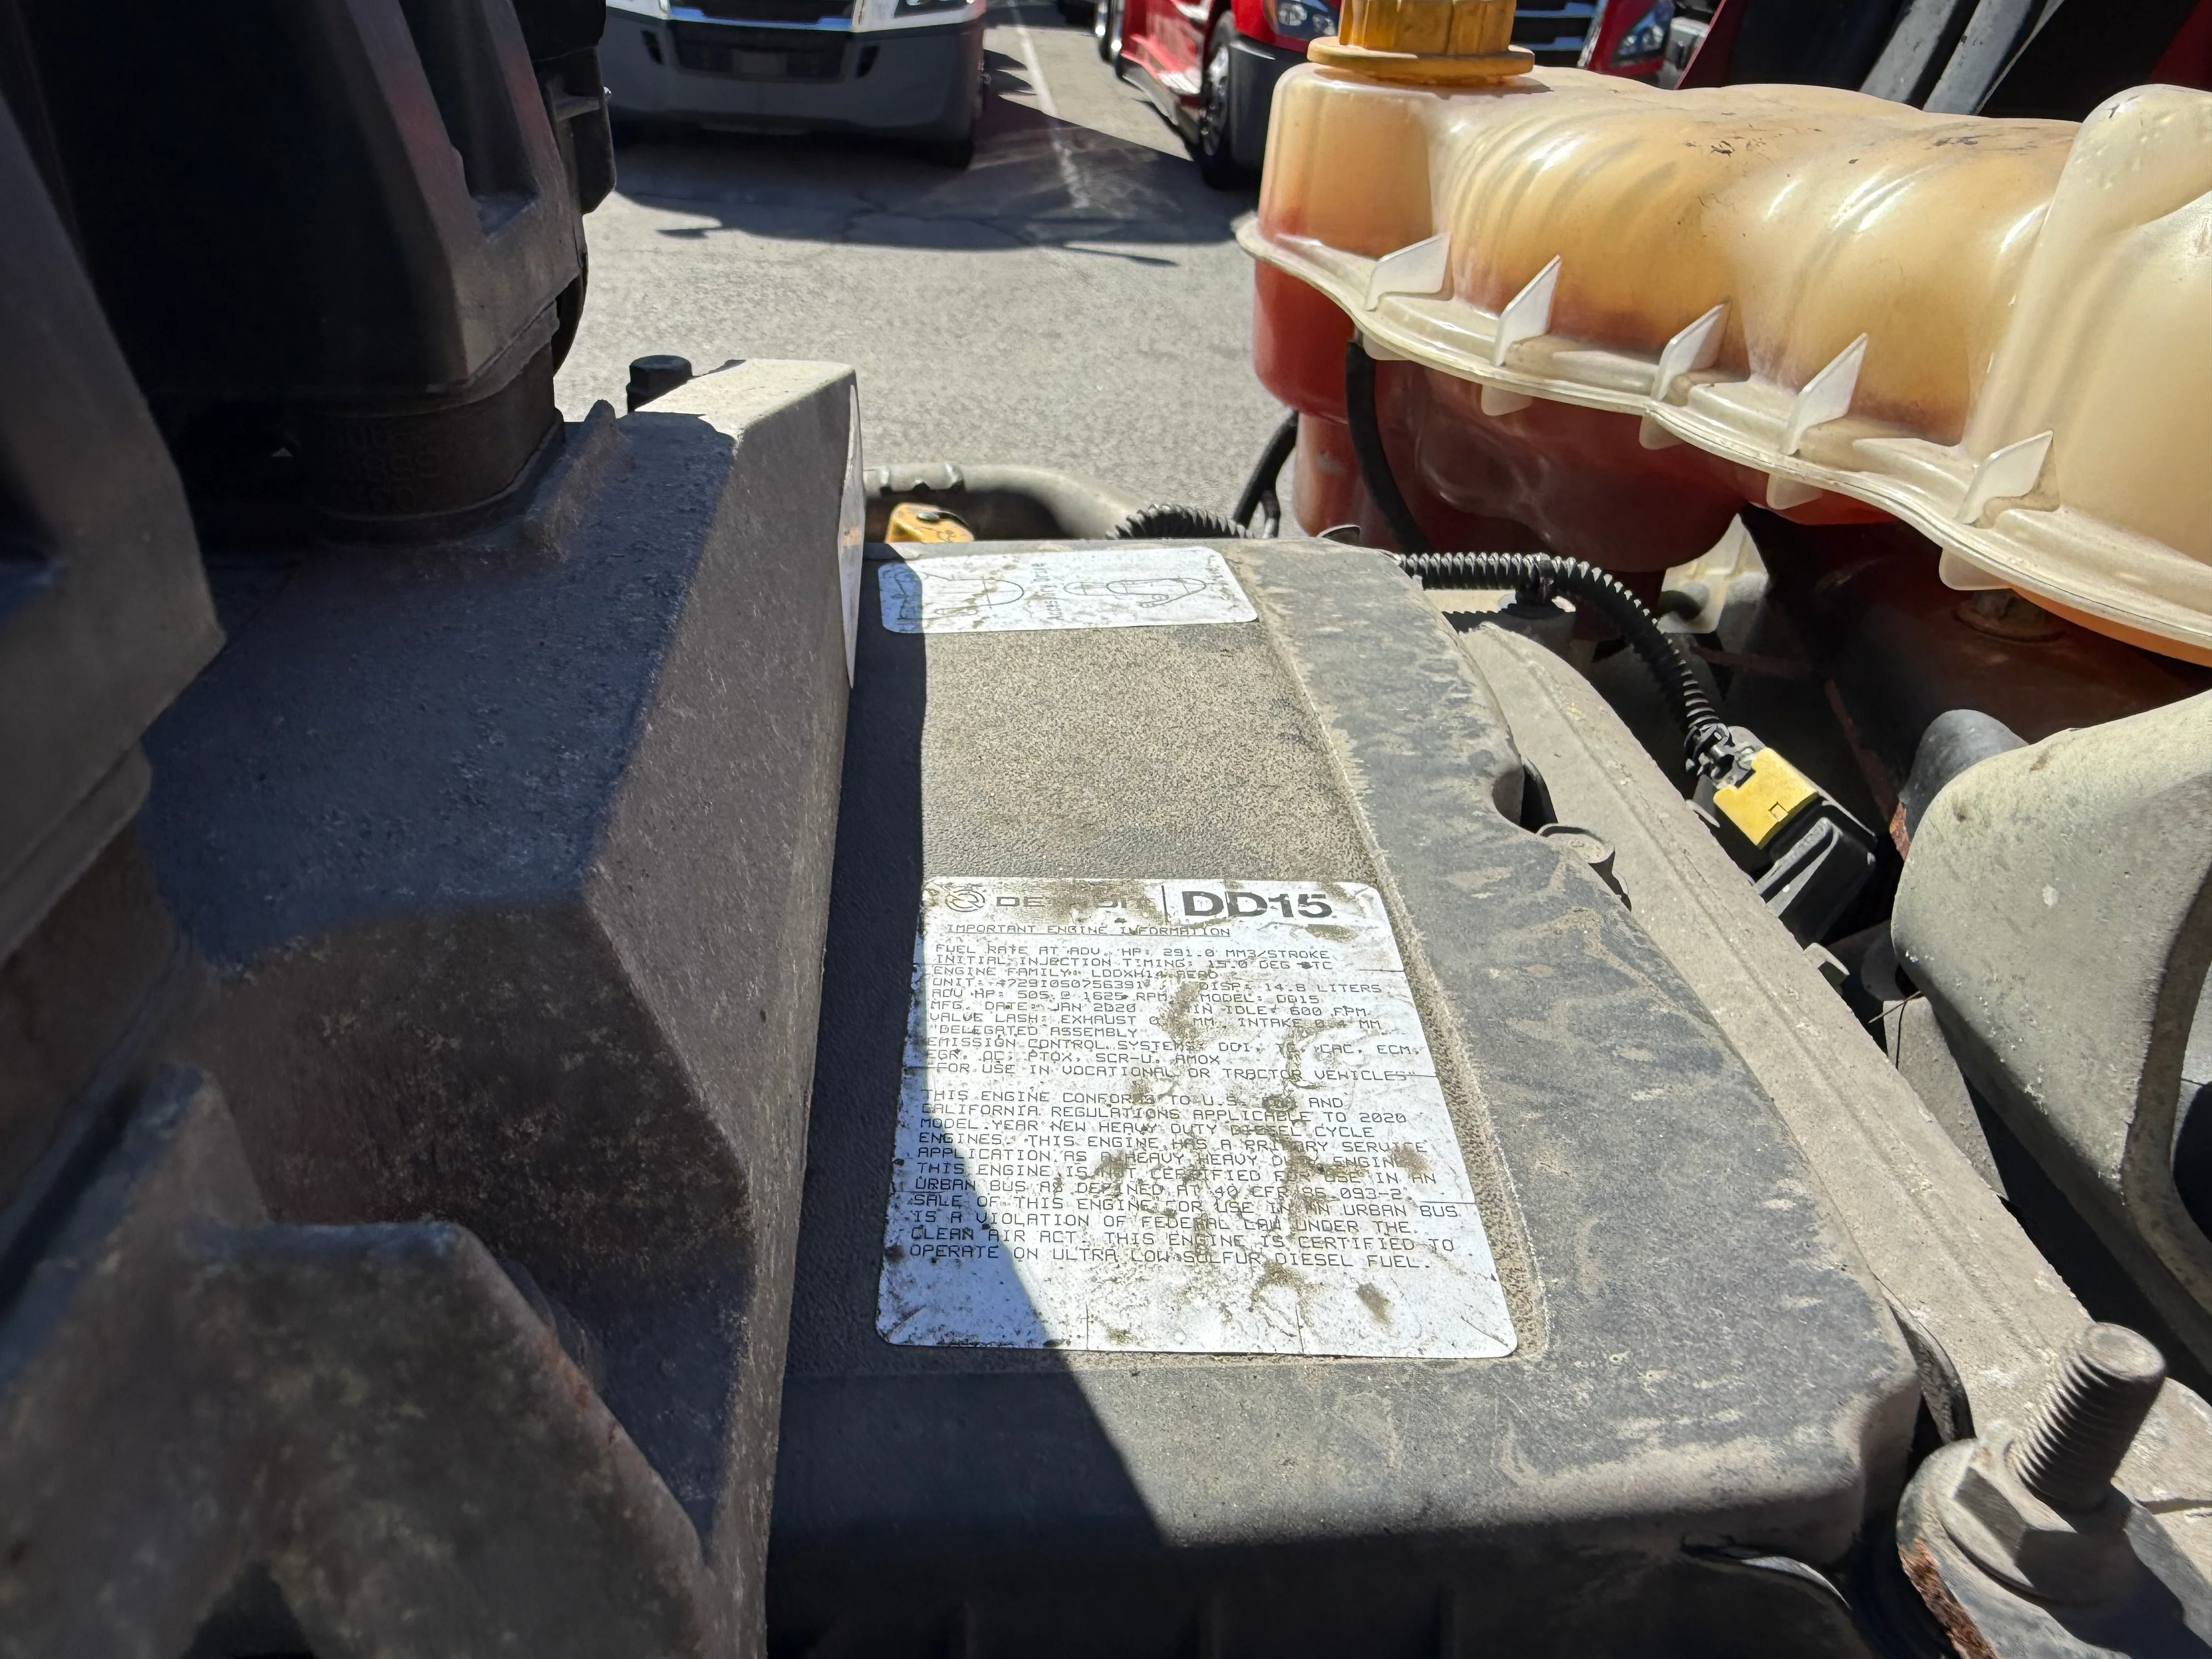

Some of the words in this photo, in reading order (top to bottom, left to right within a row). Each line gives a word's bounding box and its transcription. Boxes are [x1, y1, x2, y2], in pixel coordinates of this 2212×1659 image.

[1182, 891, 1332, 918] DD15
[947, 924, 1036, 933] IMPORTANT
[1047, 925, 1107, 934] ENGINE
[1120, 926, 1230, 936] INFORMATION
[936, 944, 976, 953] FUEL
[988, 946, 1028, 955] RATE
[1040, 946, 1058, 955] AT
[1164, 948, 1215, 957] 291.0
[1226, 949, 1330, 959] MM3/STROKE
[937, 954, 1006, 965] INITIAL
[1020, 957, 1111, 967] INJECTION
[1260, 961, 1290, 969] DEG
[934, 966, 997, 976] ENGINE
[1018, 990, 1049, 999] 505
[1084, 992, 1124, 1001] 1625
[1136, 992, 1167, 1001] RPM
[1317, 984, 1382, 993] LITERS
[1049, 1003, 1081, 1012] JAN
[1093, 1003, 1136, 1012] 2020
[1061, 1015, 1136, 1024] EXHAUST
[1359, 1020, 1382, 1029] MM
[928, 1037, 1015, 1047] EMISSION
[1028, 1039, 1105, 1049] CONTROL
[1175, 1054, 1220, 1064] AMOX
[982, 1064, 1015, 1074] USE
[1029, 1064, 1049, 1075] IN
[1062, 1065, 1176, 1077] VOCATIONAL
[1188, 1068, 1210, 1077] OR
[921, 1089, 968, 1101] THIS
[981, 1091, 1049, 1103] ENGINE
[1171, 1095, 1190, 1105] TO
[1308, 1097, 1343, 1108] AND
[922, 1103, 1039, 1116] CALIFORNIA
[1051, 1106, 1180, 1119] REGULATIONS
[1193, 1109, 1312, 1122] APPLICABLE
[1323, 1111, 1346, 1122] TO
[1359, 1112, 1407, 1123] 2020
[921, 1118, 979, 1130] MODEL
[992, 1120, 1039, 1131] YEAR
[1051, 1120, 1086, 1132] NEW
[1099, 1122, 1157, 1133] HEAVY
[1171, 1124, 1217, 1135] DUTY
[1315, 1126, 1375, 1138] CYCLE
[1028, 1135, 1074, 1147] THIS
[1088, 1136, 1159, 1148] ENGINE
[1221, 1139, 1231, 1151] A
[1245, 1139, 1328, 1152] PRIARY
[917, 1147, 1051, 1161] APPLICATION
[1064, 1151, 1087, 1161] AS
[1198, 1154, 1257, 1166] HEAVY
[917, 1162, 964, 1175] THIS
[978, 1164, 1051, 1176] ENGINE
[1066, 1166, 1087, 1177] IS
[1375, 1172, 1397, 1184] IN
[916, 1178, 976, 1190] URBAN
[990, 1180, 1025, 1192] BUS
[1177, 1184, 1200, 1197] AT
[913, 1194, 963, 1206] SALE
[977, 1195, 1000, 1207] OF
[1014, 1197, 1063, 1209] THIS
[1216, 1201, 1254, 1213] USE
[1343, 1204, 1407, 1216] URBAN
[1420, 1205, 1459, 1217] BUS
[915, 1210, 936, 1223] IS
[951, 1211, 962, 1223] A
[976, 1212, 1089, 1227] VIOLATION
[1104, 1215, 1126, 1227] OF
[1297, 1220, 1359, 1233] UNDER
[911, 1227, 974, 1240] CLEAN
[988, 1229, 1025, 1242] AIR
[1104, 1232, 1155, 1244] THIS
[1261, 1234, 1285, 1248] IS
[1298, 1235, 1414, 1250] CERTIFIED
[1427, 1238, 1454, 1252] TO
[910, 1244, 999, 1258] OPERATE
[1014, 1247, 1038, 1259] ON
[1053, 1248, 1119, 1262] ULTRA
[1131, 1250, 1169, 1262] LOW
[1276, 1252, 1353, 1266] DIESEL
